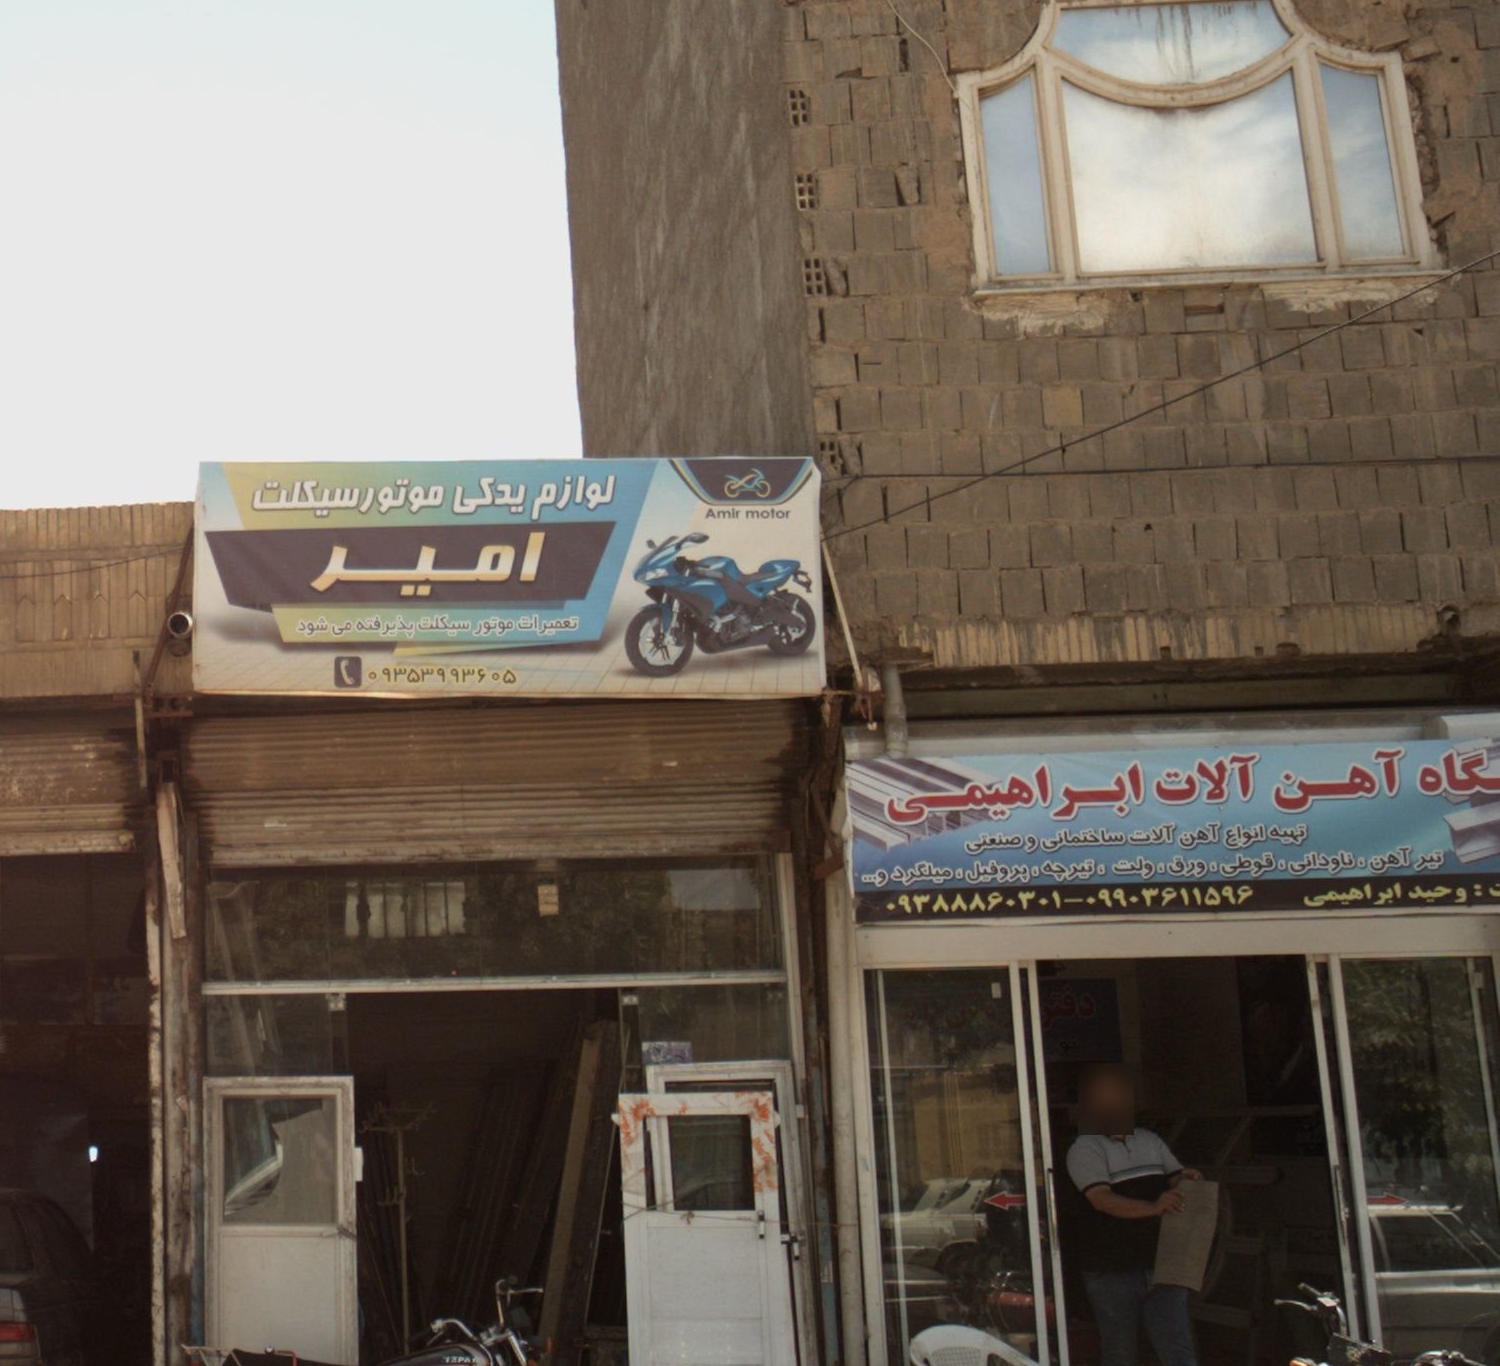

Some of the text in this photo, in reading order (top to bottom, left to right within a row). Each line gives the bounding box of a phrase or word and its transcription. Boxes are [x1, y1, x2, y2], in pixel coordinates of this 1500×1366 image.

[452, 477, 526, 514] یدکی
[529, 474, 615, 521] لوازم
[705, 508, 791, 519] Amir motor
[310, 531, 546, 596] امیر
[298, 615, 579, 638] تعمیرات موتور سیکلت پذیرفته می شود
[887, 748, 1500, 823] گاه آهن آلات ابراهیمی
[964, 823, 1307, 855] تهیه انواع آهن آلات ساختمانی و صنعتی
[1416, 850, 1444, 870] تیر
[891, 861, 953, 885] میلگرد
[1303, 882, 1401, 907] ابراهیمی
[1408, 884, 1468, 903] وحید
